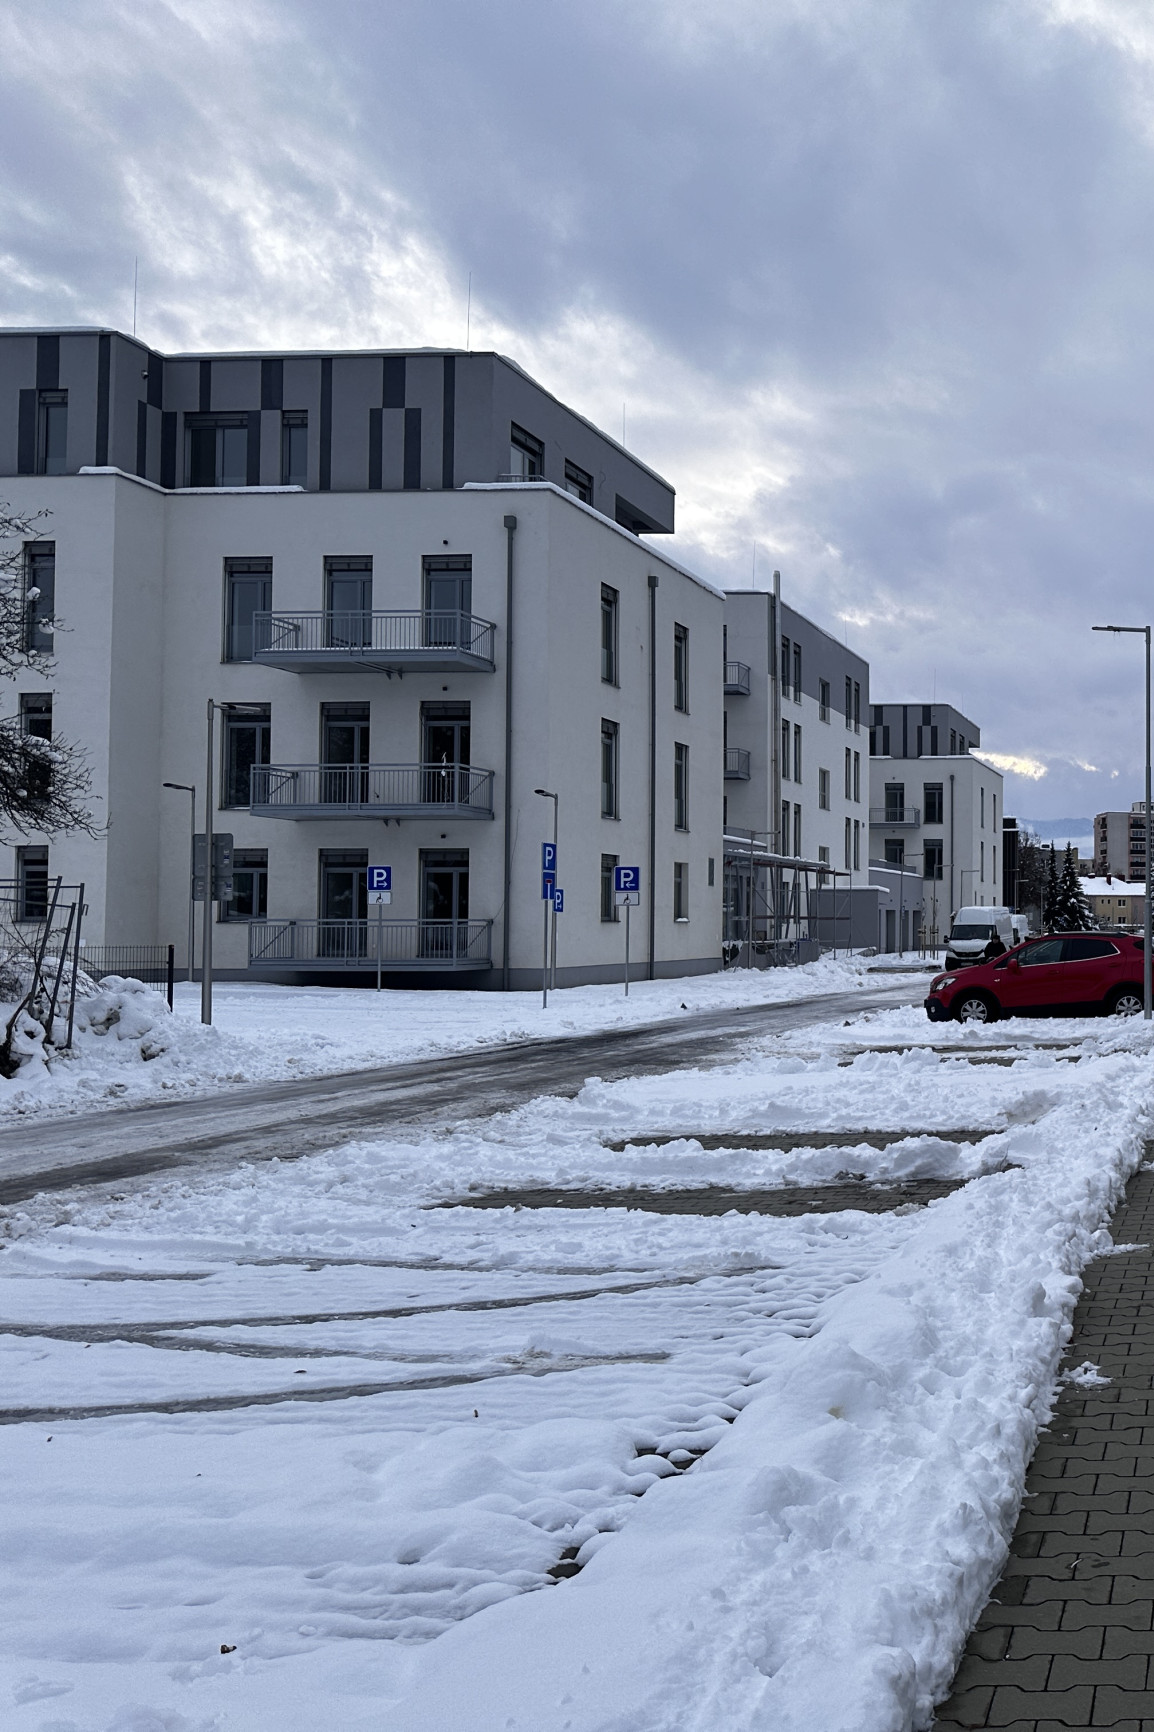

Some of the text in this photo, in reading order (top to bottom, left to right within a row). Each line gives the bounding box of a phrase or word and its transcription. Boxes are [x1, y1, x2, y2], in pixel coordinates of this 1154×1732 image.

[545, 846, 554, 868] P
[373, 869, 387, 888] P
[620, 869, 634, 889] P
[555, 891, 562, 910] P
